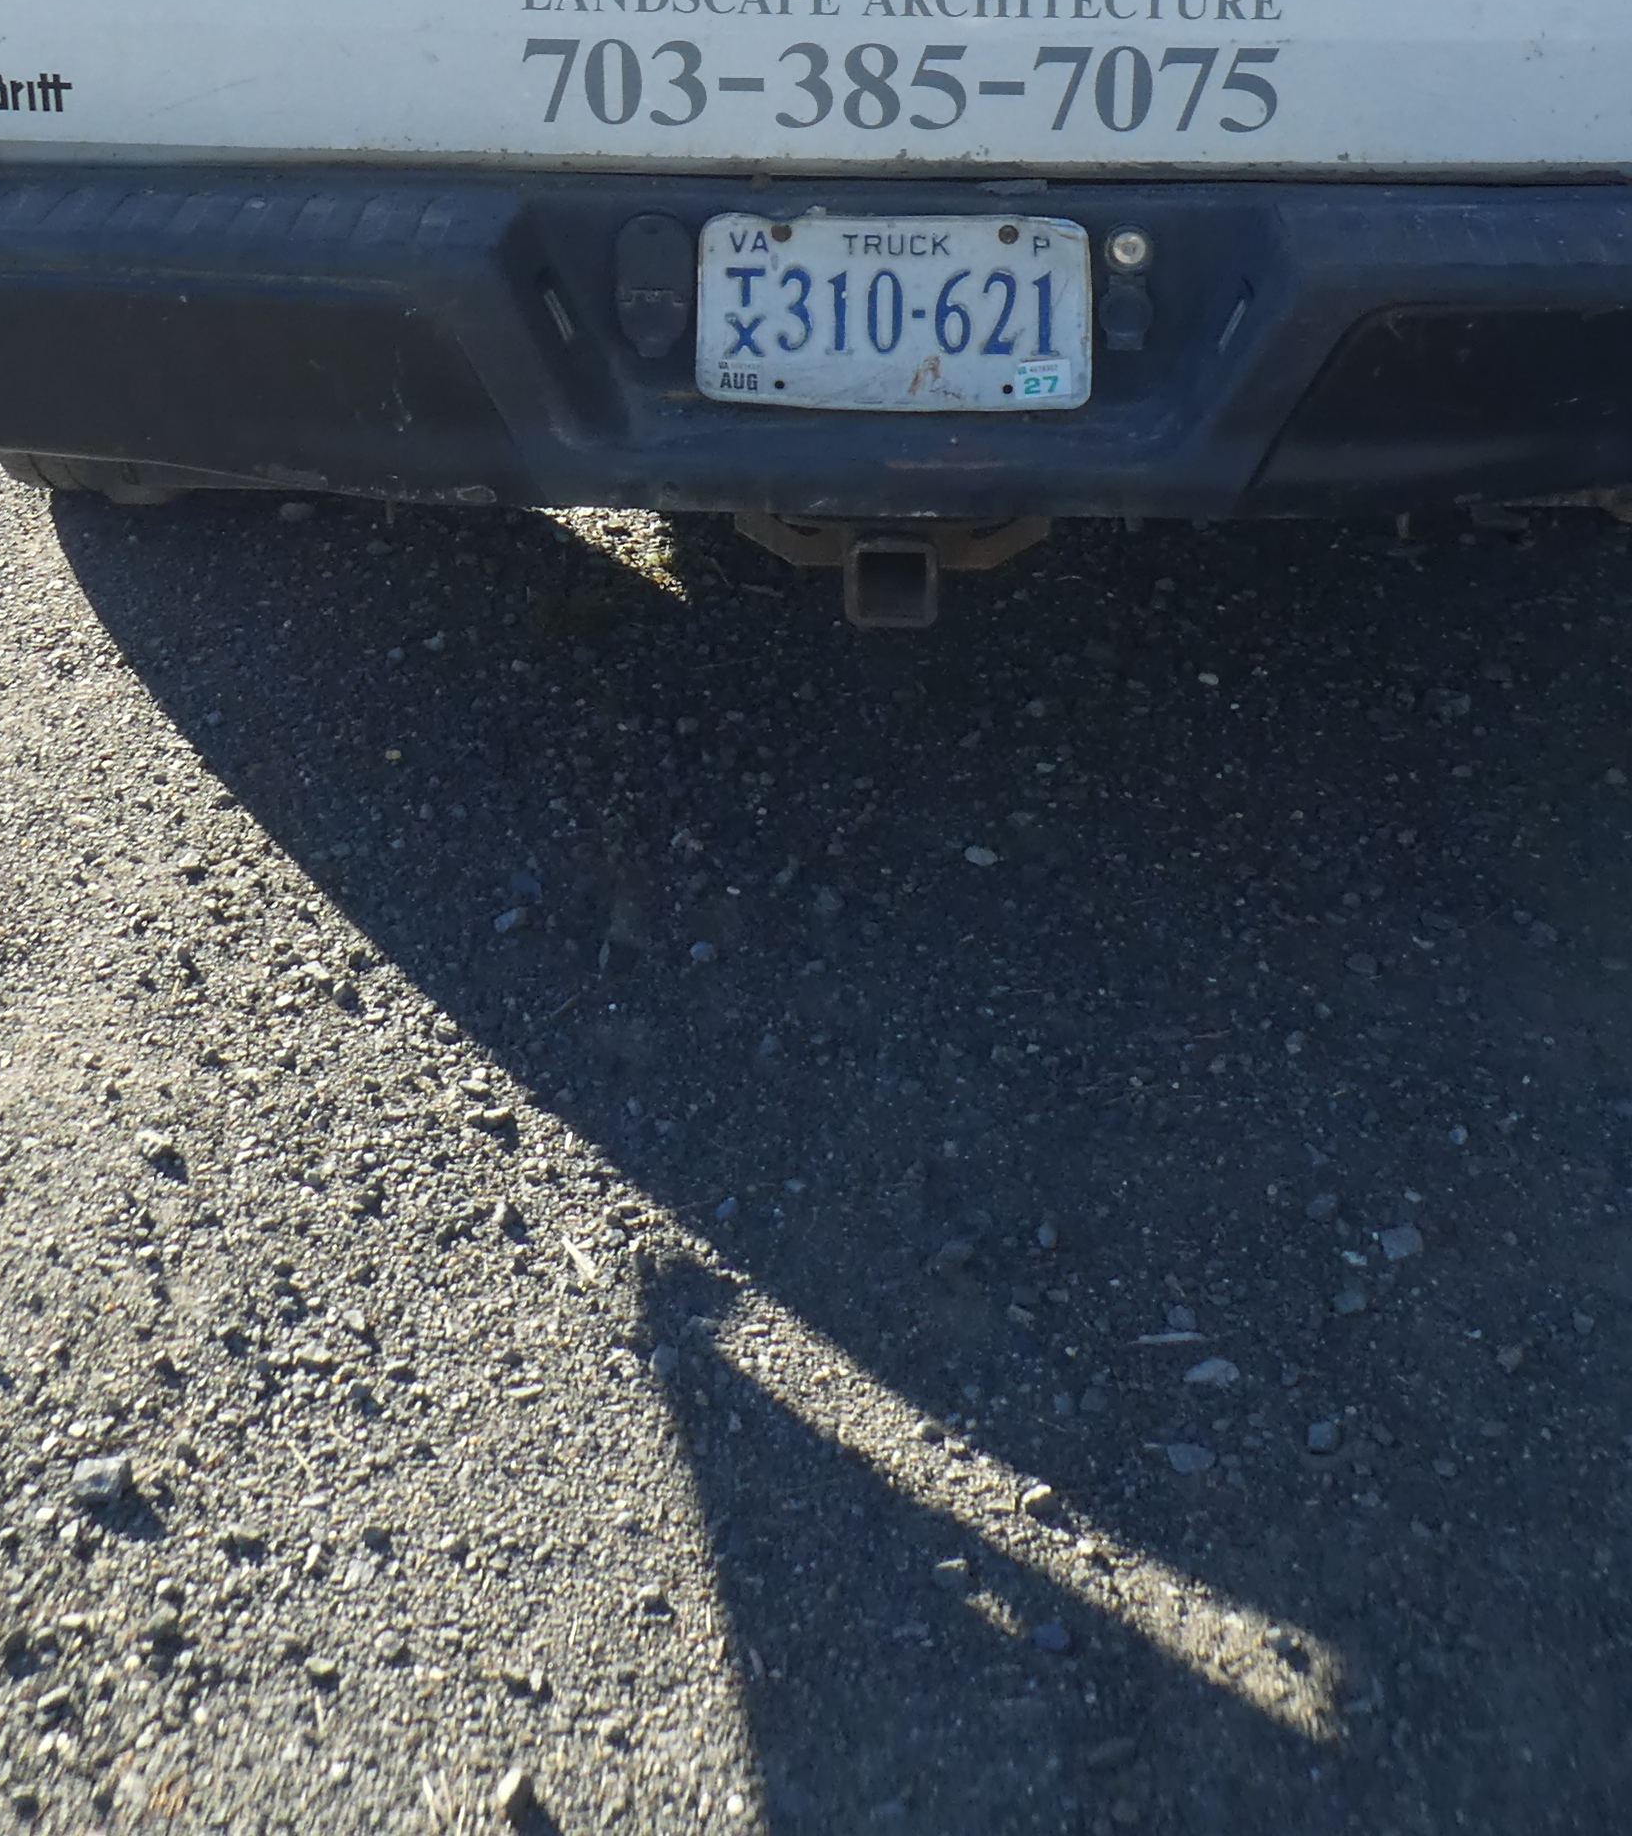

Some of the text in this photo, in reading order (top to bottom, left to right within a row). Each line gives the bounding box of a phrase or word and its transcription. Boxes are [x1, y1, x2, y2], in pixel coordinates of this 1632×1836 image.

[522, 37, 1280, 134] 703-385-7075
[729, 230, 769, 254] VA
[843, 233, 951, 257] TRUCK
[1032, 235, 1051, 256] P
[776, 266, 1060, 356] 310-621
[720, 372, 758, 391] AUG
[1024, 375, 1059, 395] 27
